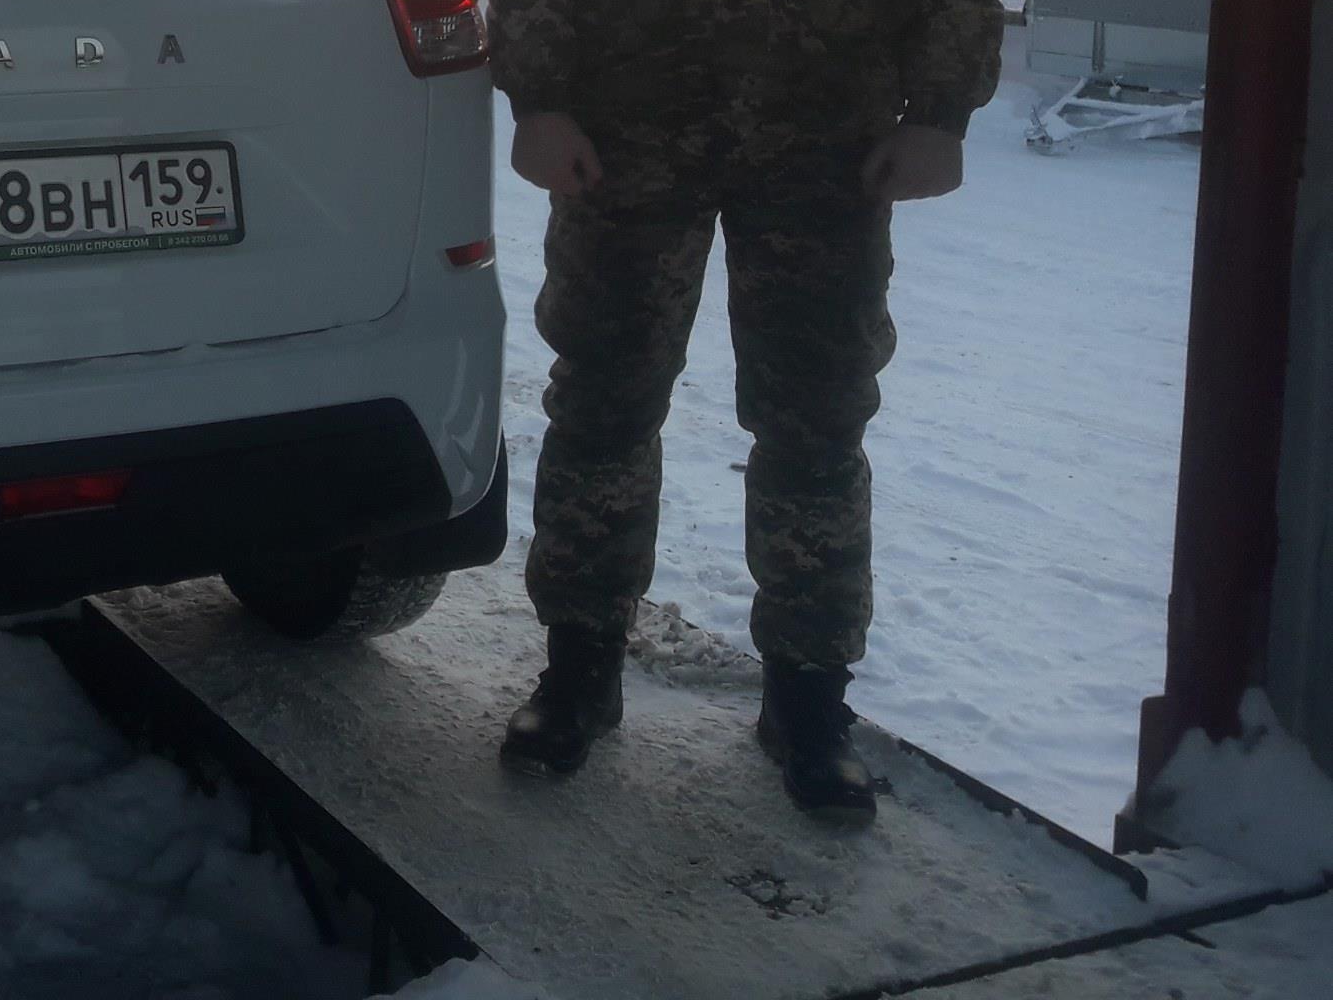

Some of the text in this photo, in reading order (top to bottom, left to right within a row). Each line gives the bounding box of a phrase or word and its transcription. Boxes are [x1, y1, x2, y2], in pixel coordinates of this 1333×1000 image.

[128, 157, 213, 208] 159
[151, 208, 194, 229] RUS
[10, 240, 83, 257] АВТОМОБИЛИ
[94, 237, 149, 250] ПРОБЕГОМ
